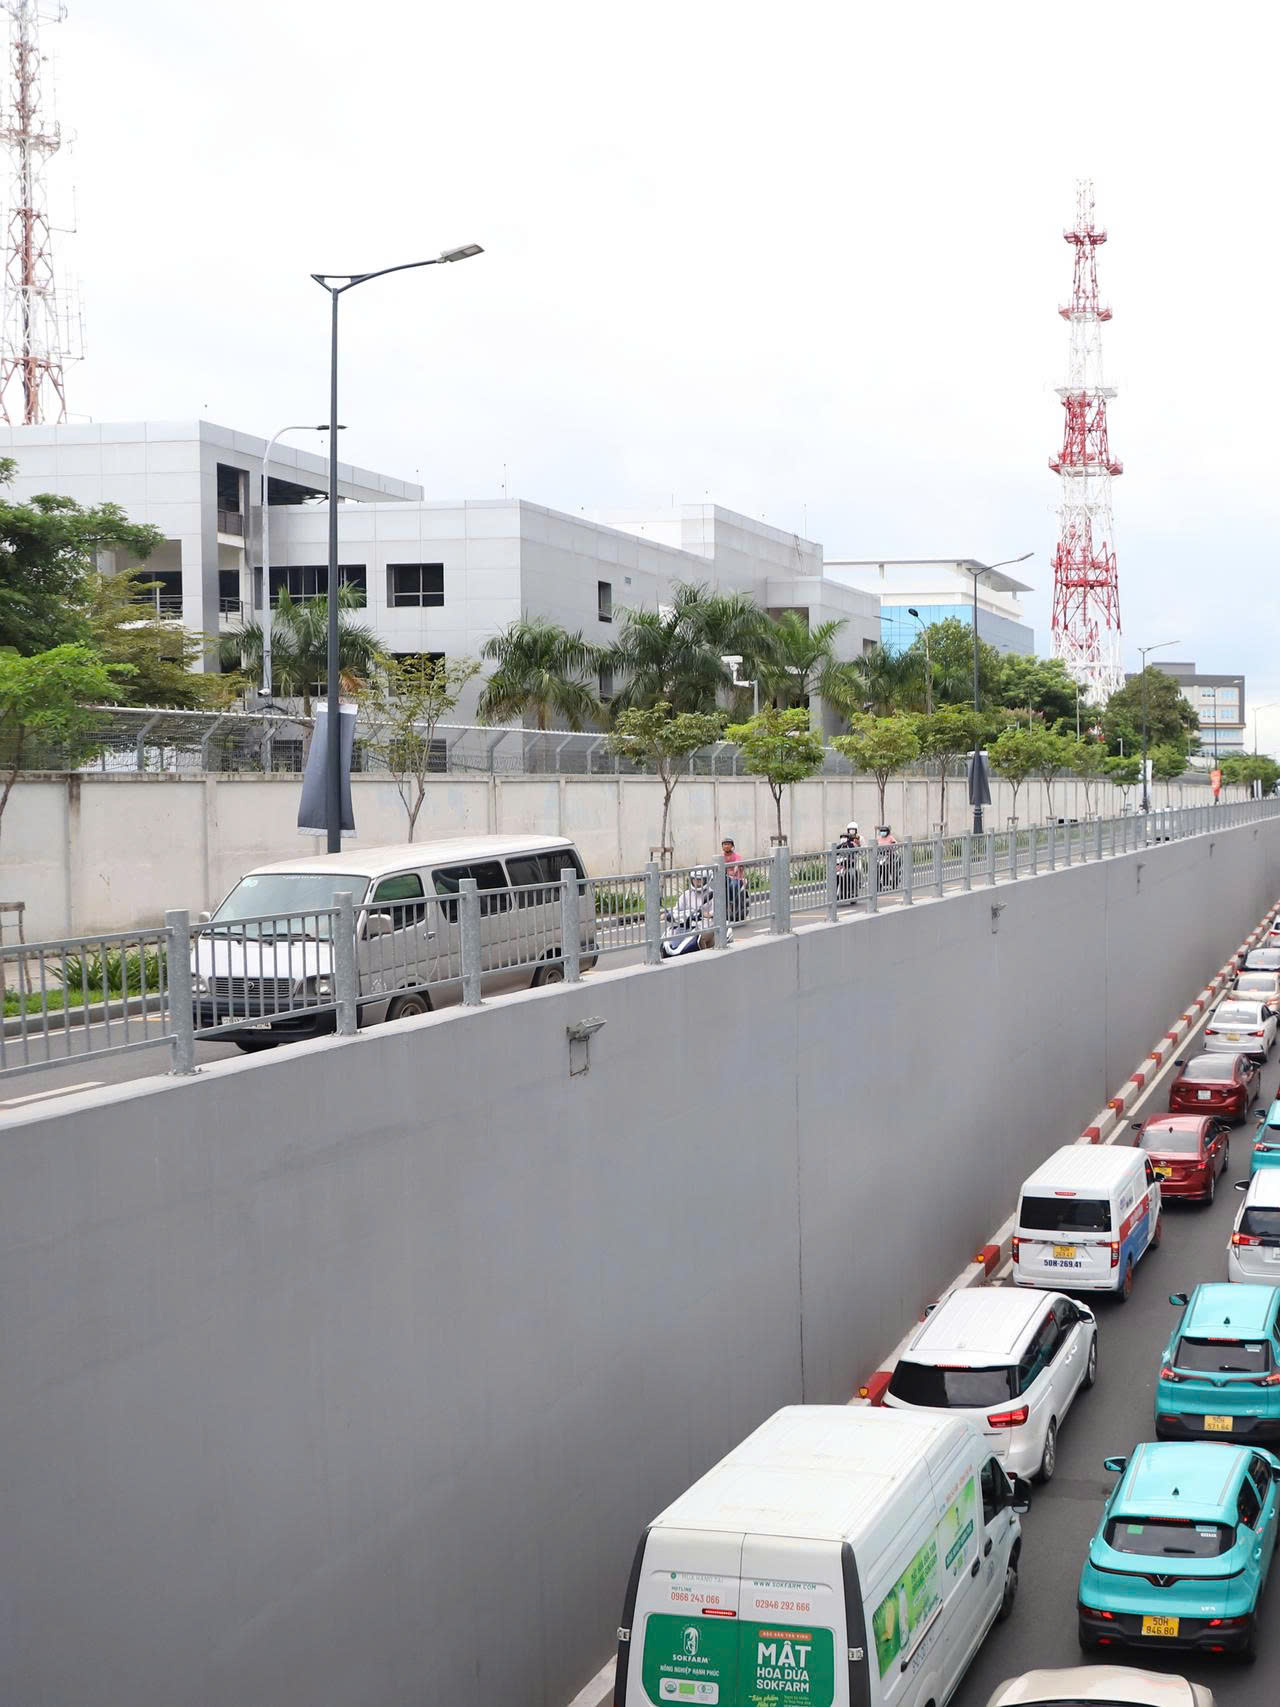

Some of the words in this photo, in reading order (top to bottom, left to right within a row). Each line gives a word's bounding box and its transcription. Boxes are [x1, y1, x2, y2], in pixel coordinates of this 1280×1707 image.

[690, 1593, 704, 1603] 243
[706, 1594, 720, 1605] 066
[780, 1601, 795, 1611] 292
[672, 1654, 709, 1664] SOKFARM
[757, 1640, 812, 1668] MẬT
[757, 1666, 782, 1680] HOA
[784, 1667, 810, 1682] DỪA
[756, 1679, 810, 1693] SOKFARM
